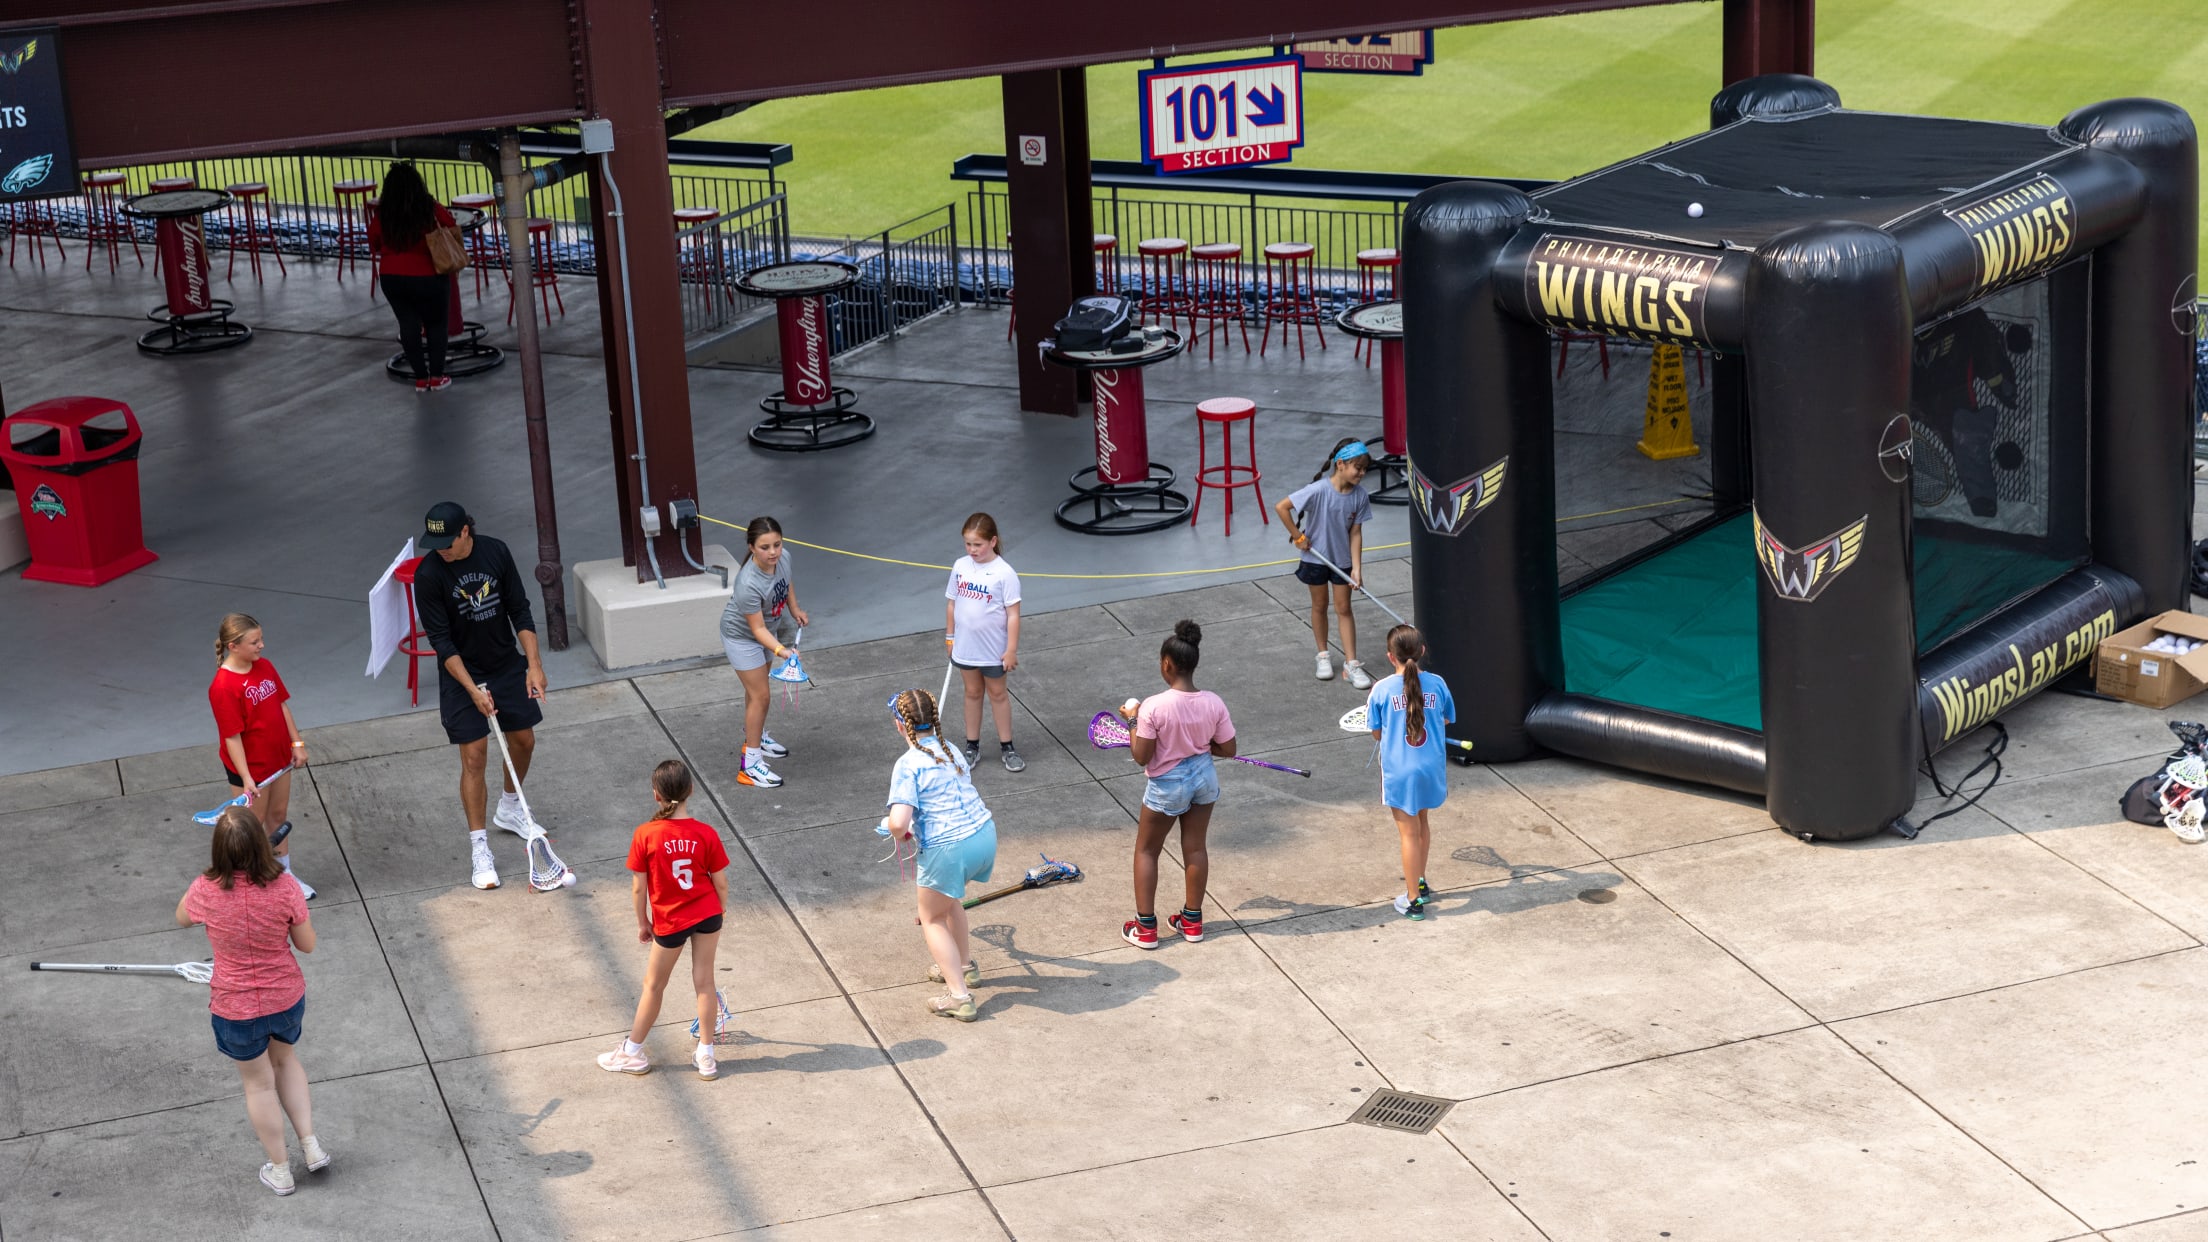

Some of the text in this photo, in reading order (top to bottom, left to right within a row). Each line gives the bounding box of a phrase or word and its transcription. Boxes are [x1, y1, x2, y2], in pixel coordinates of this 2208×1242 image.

[1324, 53, 1393, 70] SECTION
[0, 105, 27, 129] TS
[1166, 80, 1238, 144] 101
[1182, 144, 1271, 169] SECTION
[1958, 179, 2058, 228] PHILADELPHIA
[1972, 196, 2070, 287] WINGS
[1544, 239, 1705, 278] PHILADELPHIA
[1536, 261, 1701, 338] WINGS
[796, 295, 826, 400] Yuengling
[1092, 368, 1121, 481] Yuengling
[452, 572, 498, 599] PHADELPHIA
[956, 580, 989, 594] LAYBALL
[466, 607, 497, 622] LAROSSE
[1931, 609, 2116, 741] WingsLax.com
[1392, 692, 1437, 711] HAER
[664, 839, 698, 854] STOTT
[672, 858, 694, 890] 5
